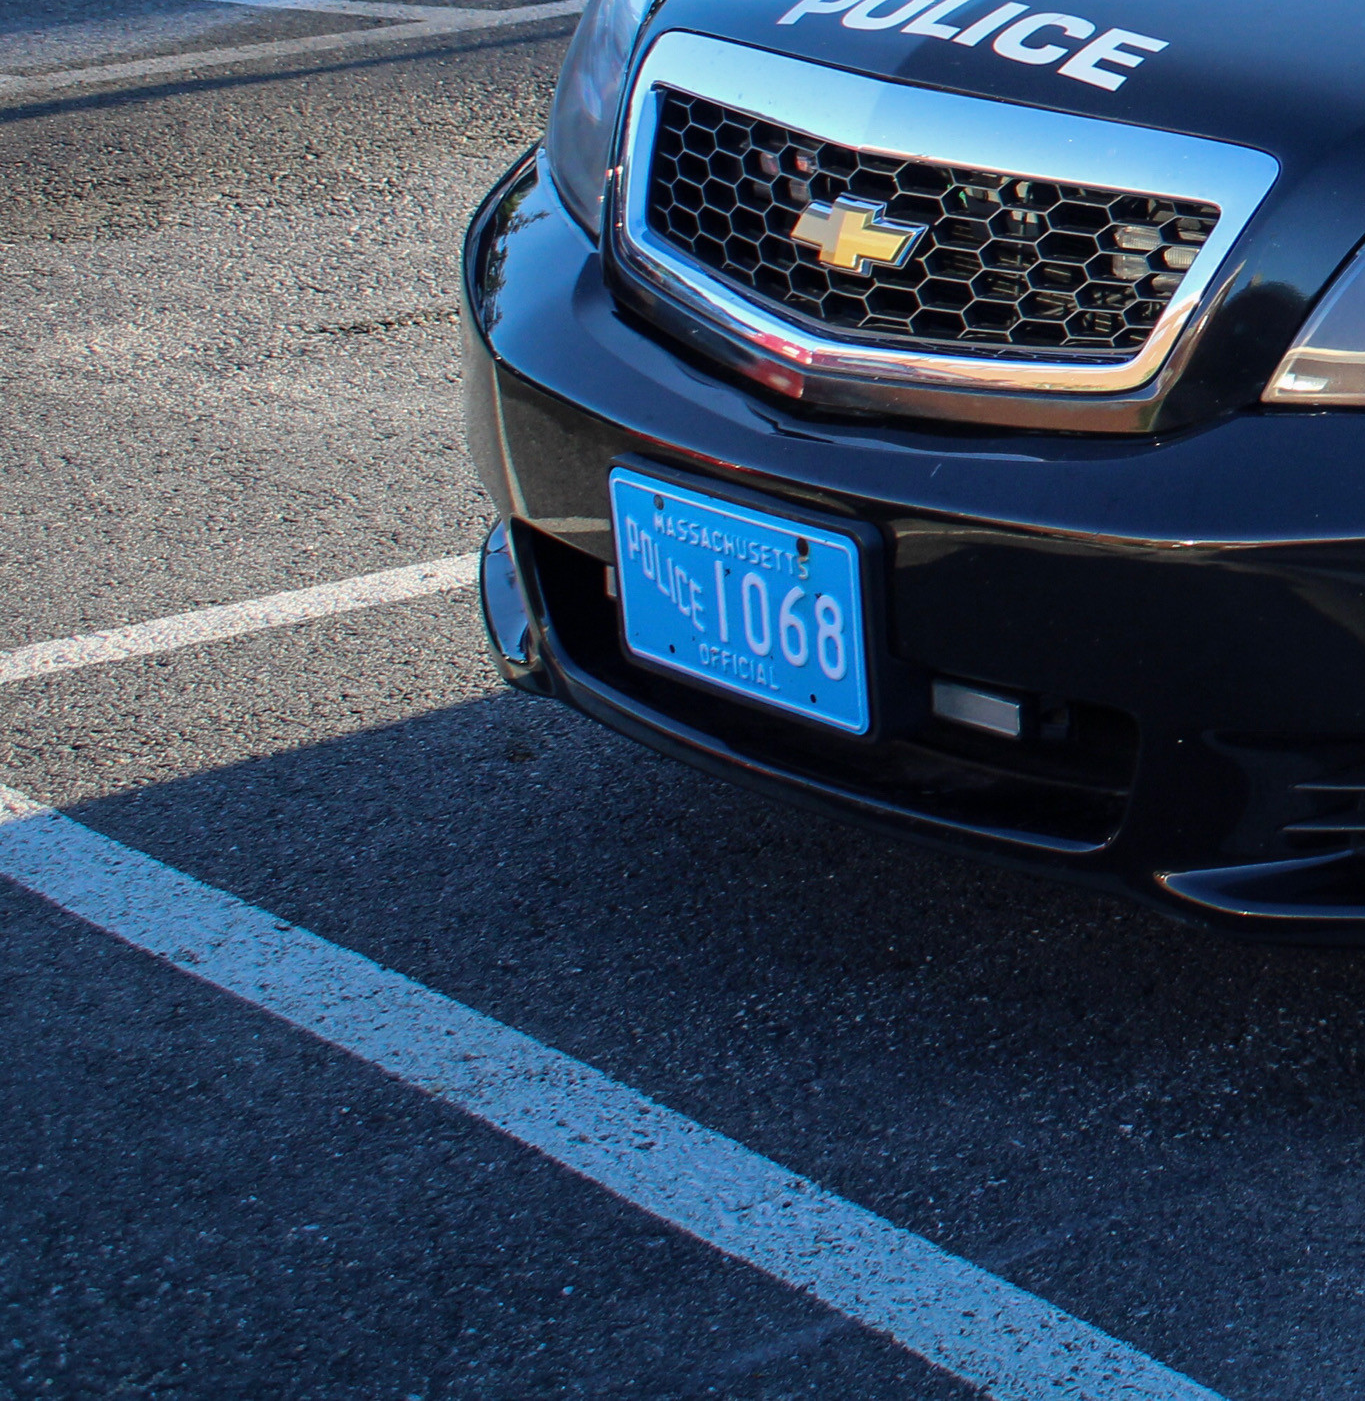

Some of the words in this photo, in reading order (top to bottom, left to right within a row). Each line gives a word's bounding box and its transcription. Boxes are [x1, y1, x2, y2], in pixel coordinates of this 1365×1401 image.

[653, 511, 809, 580] MASSACHUSETTS
[625, 515, 705, 632] POLICE
[714, 560, 847, 681] 1068
[700, 643, 781, 690] OFFICIAL
